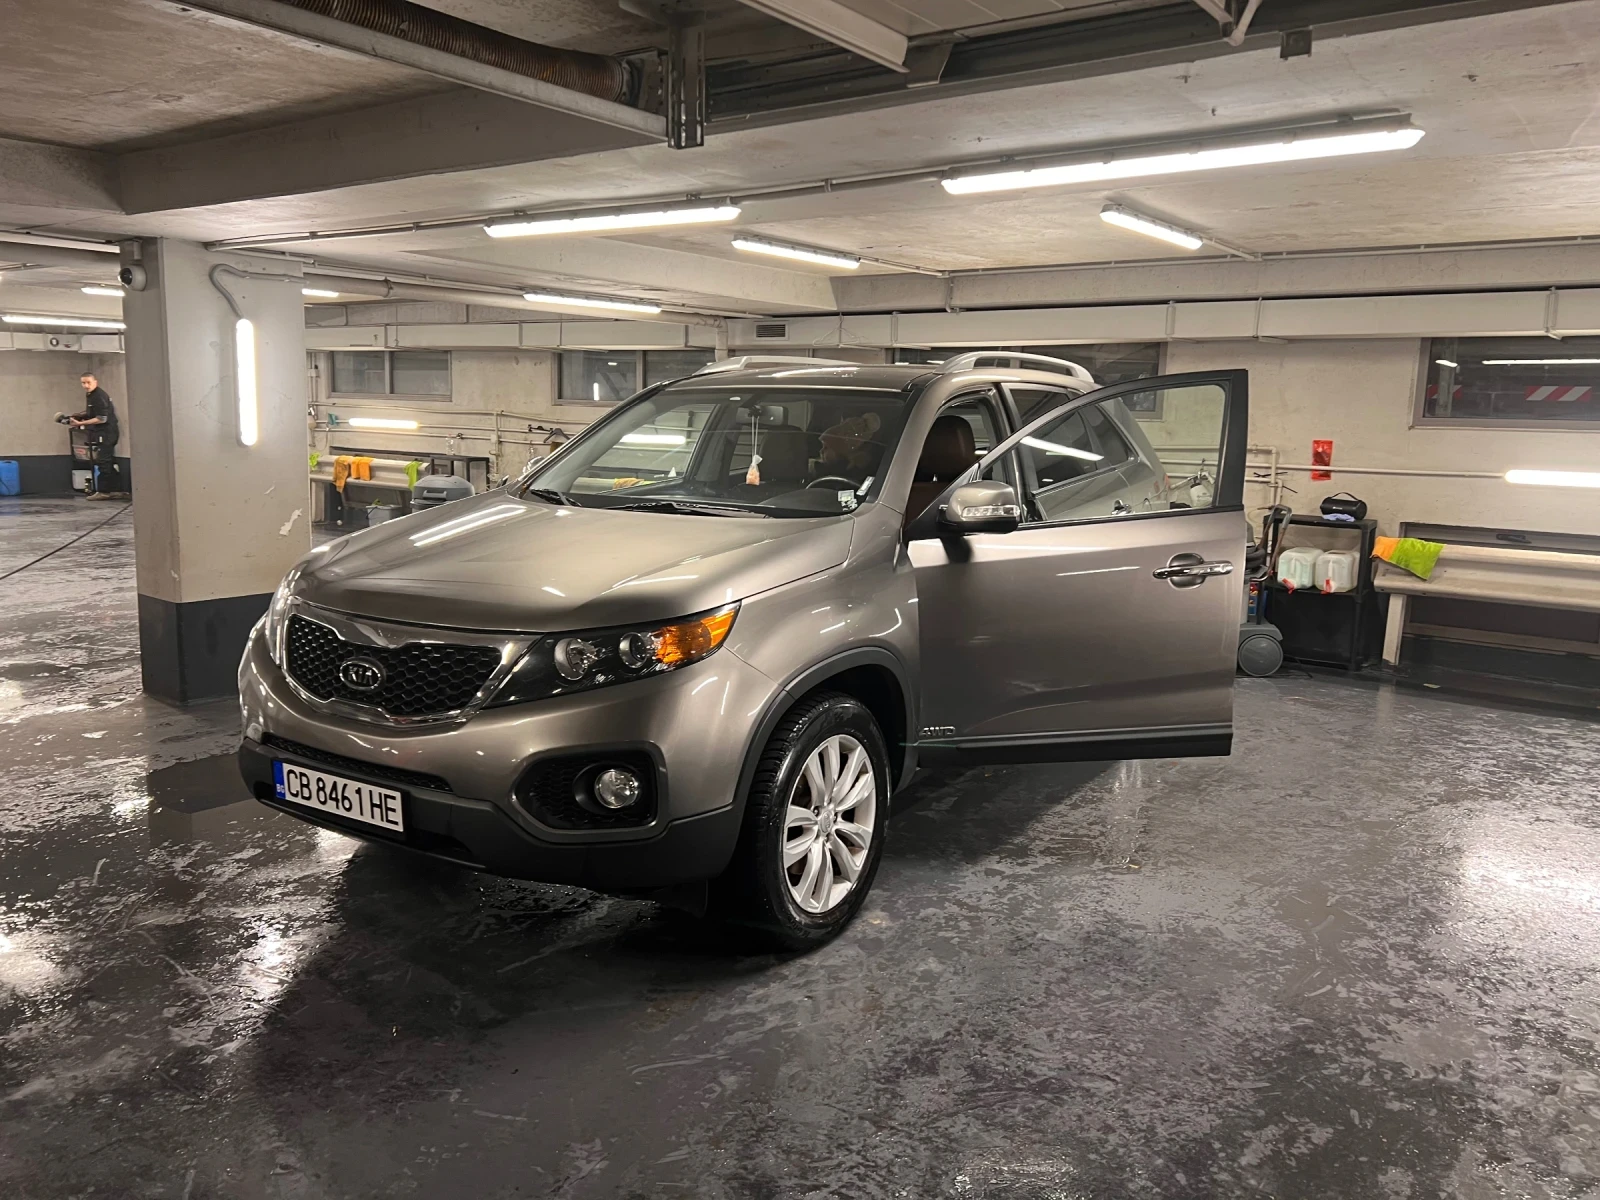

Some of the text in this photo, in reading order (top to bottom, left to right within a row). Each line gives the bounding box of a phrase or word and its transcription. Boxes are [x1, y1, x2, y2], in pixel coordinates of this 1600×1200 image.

[276, 783, 285, 794] BG
[286, 768, 399, 826] CB 8461 HE
